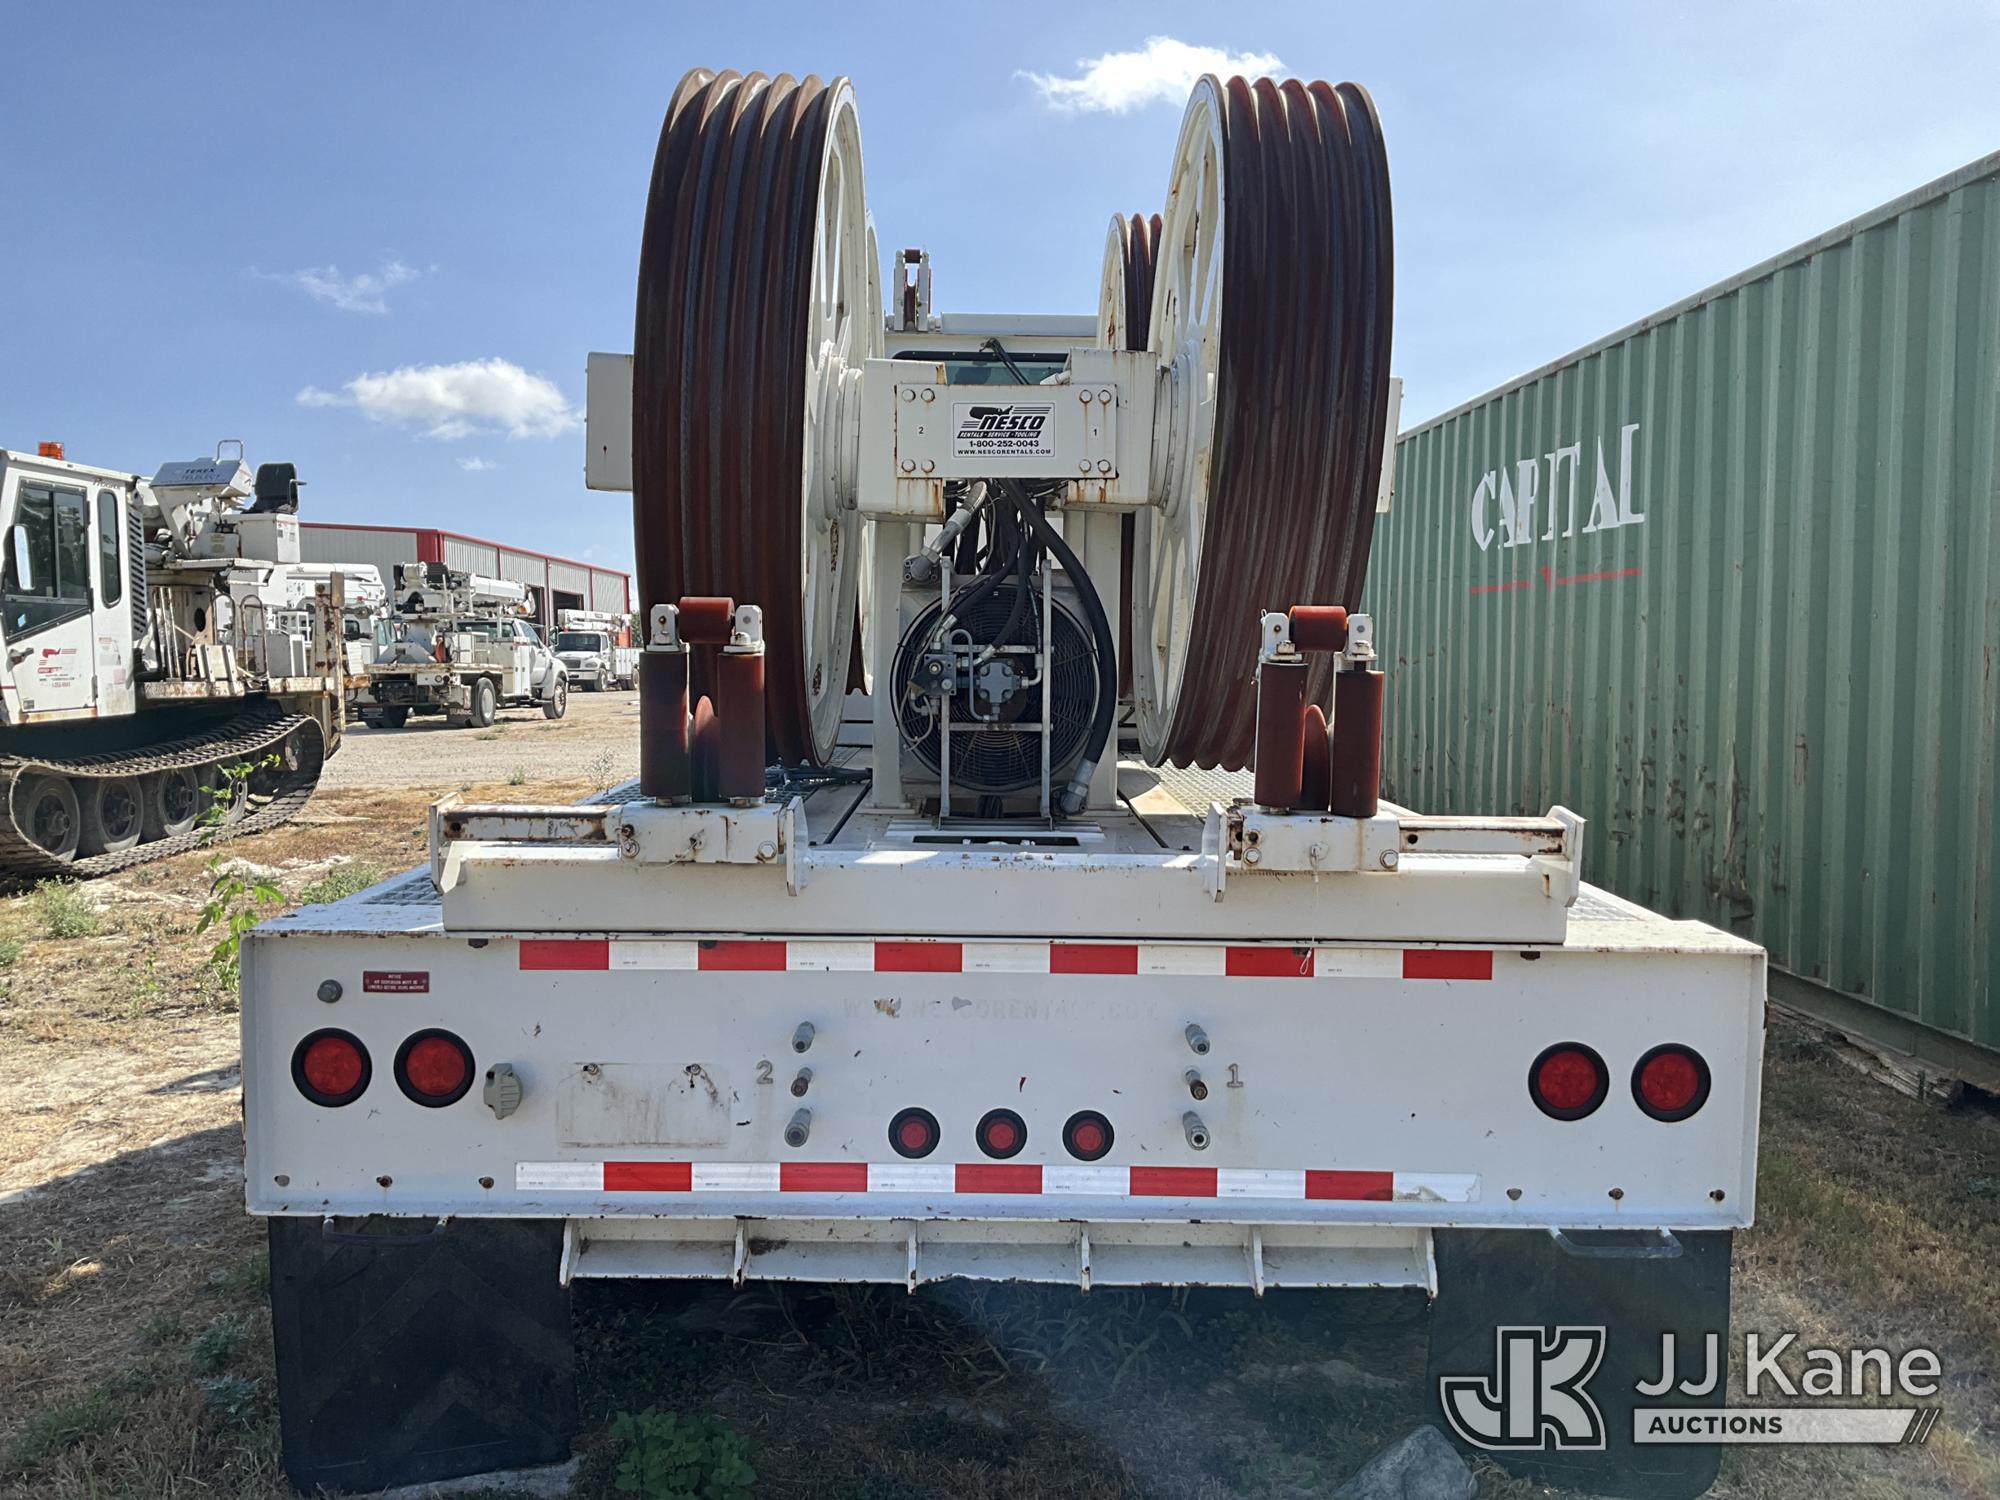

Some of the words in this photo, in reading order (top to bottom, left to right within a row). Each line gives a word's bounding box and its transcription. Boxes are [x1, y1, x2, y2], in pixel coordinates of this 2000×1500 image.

[918, 426, 924, 435] 2
[1093, 428, 1098, 437] 1
[969, 440, 1039, 448] 1-800-252-0043
[1471, 423, 1645, 551] CAPITAL
[755, 1059, 774, 1085] 2
[1226, 1063, 1244, 1088] 1
